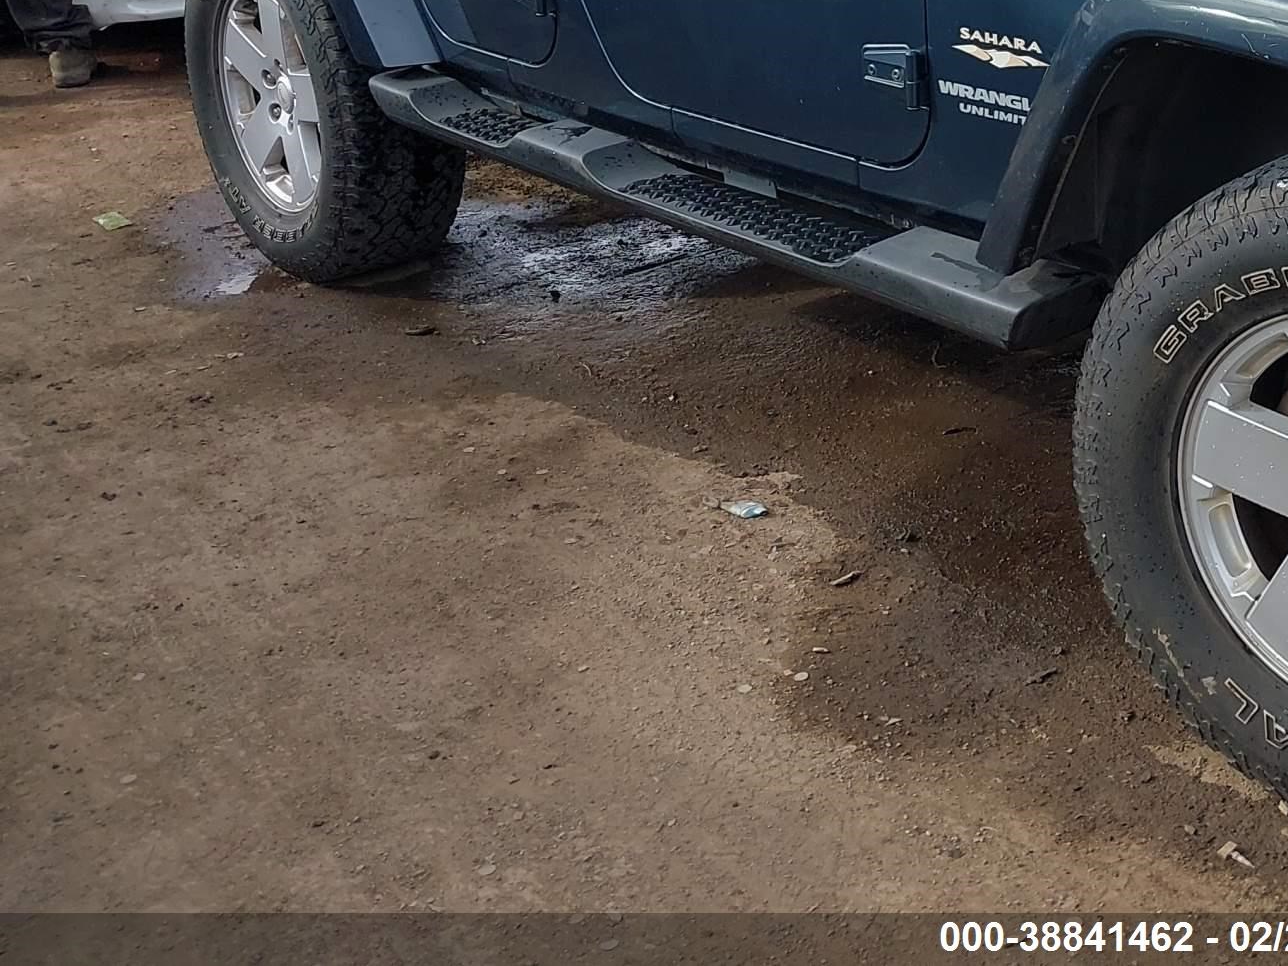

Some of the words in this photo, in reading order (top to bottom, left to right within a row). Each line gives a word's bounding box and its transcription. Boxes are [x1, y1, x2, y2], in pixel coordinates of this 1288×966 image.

[959, 27, 1043, 54] SAHARA
[938, 79, 1032, 112] WRANGL
[958, 102, 1028, 126] UNLIMIT
